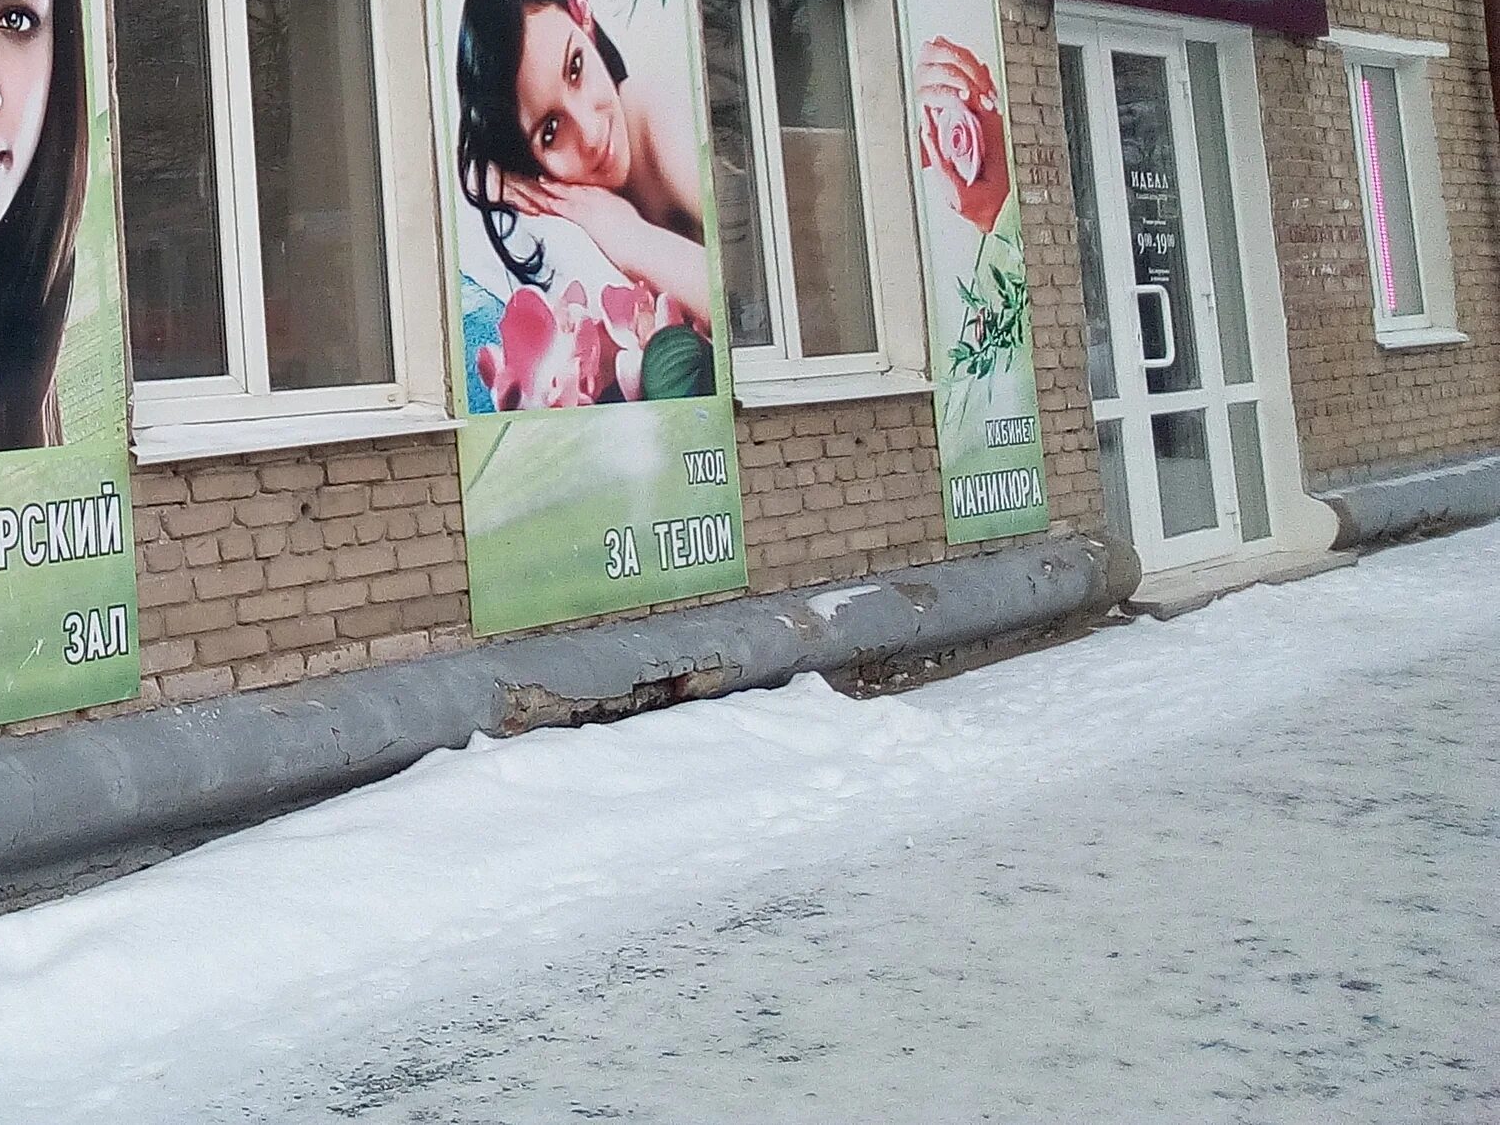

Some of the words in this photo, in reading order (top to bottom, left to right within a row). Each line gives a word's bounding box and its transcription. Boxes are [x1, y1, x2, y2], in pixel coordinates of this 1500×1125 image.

[1131, 171, 1169, 189] ИДЕАЛ
[985, 416, 1036, 448] КАБИНЕТ
[683, 449, 728, 485] УХОД
[950, 467, 1043, 519] МАНИКЮРА
[604, 526, 641, 579] ЗА
[653, 512, 735, 571] ТЕЛОМ
[63, 604, 129, 665] ЗАЛ
